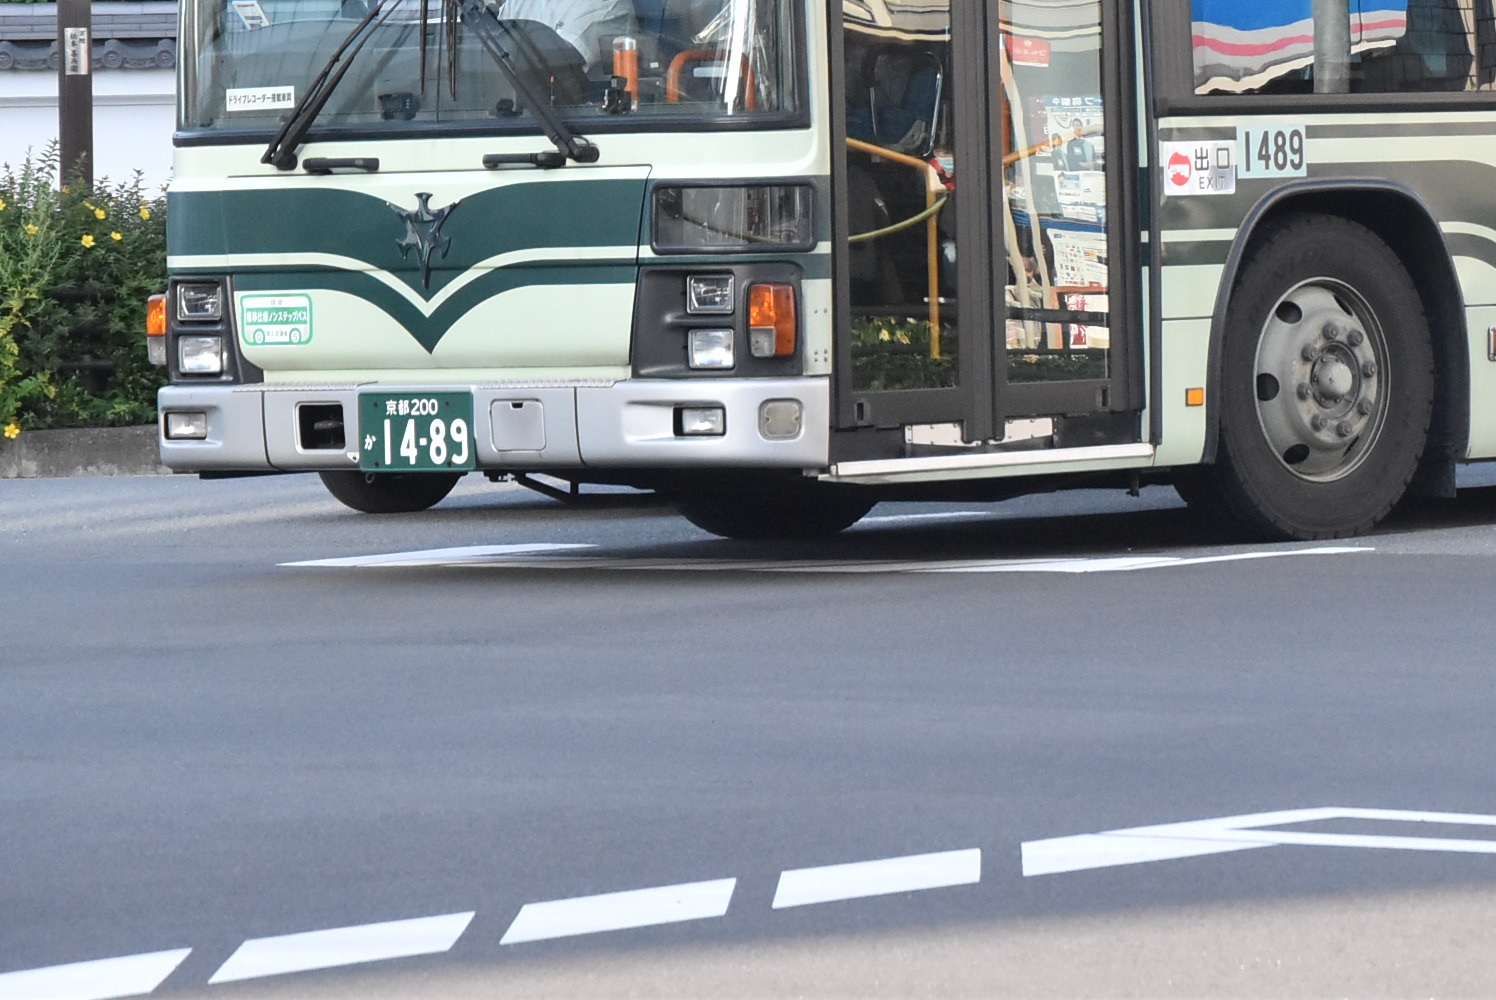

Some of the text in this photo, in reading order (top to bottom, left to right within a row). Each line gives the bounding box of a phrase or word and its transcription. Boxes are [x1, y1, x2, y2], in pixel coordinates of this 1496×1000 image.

[1194, 146, 1231, 171] 出口
[1244, 129, 1304, 172] 1489
[1199, 176, 1226, 190] EXIT
[364, 418, 469, 465] か 14-89
